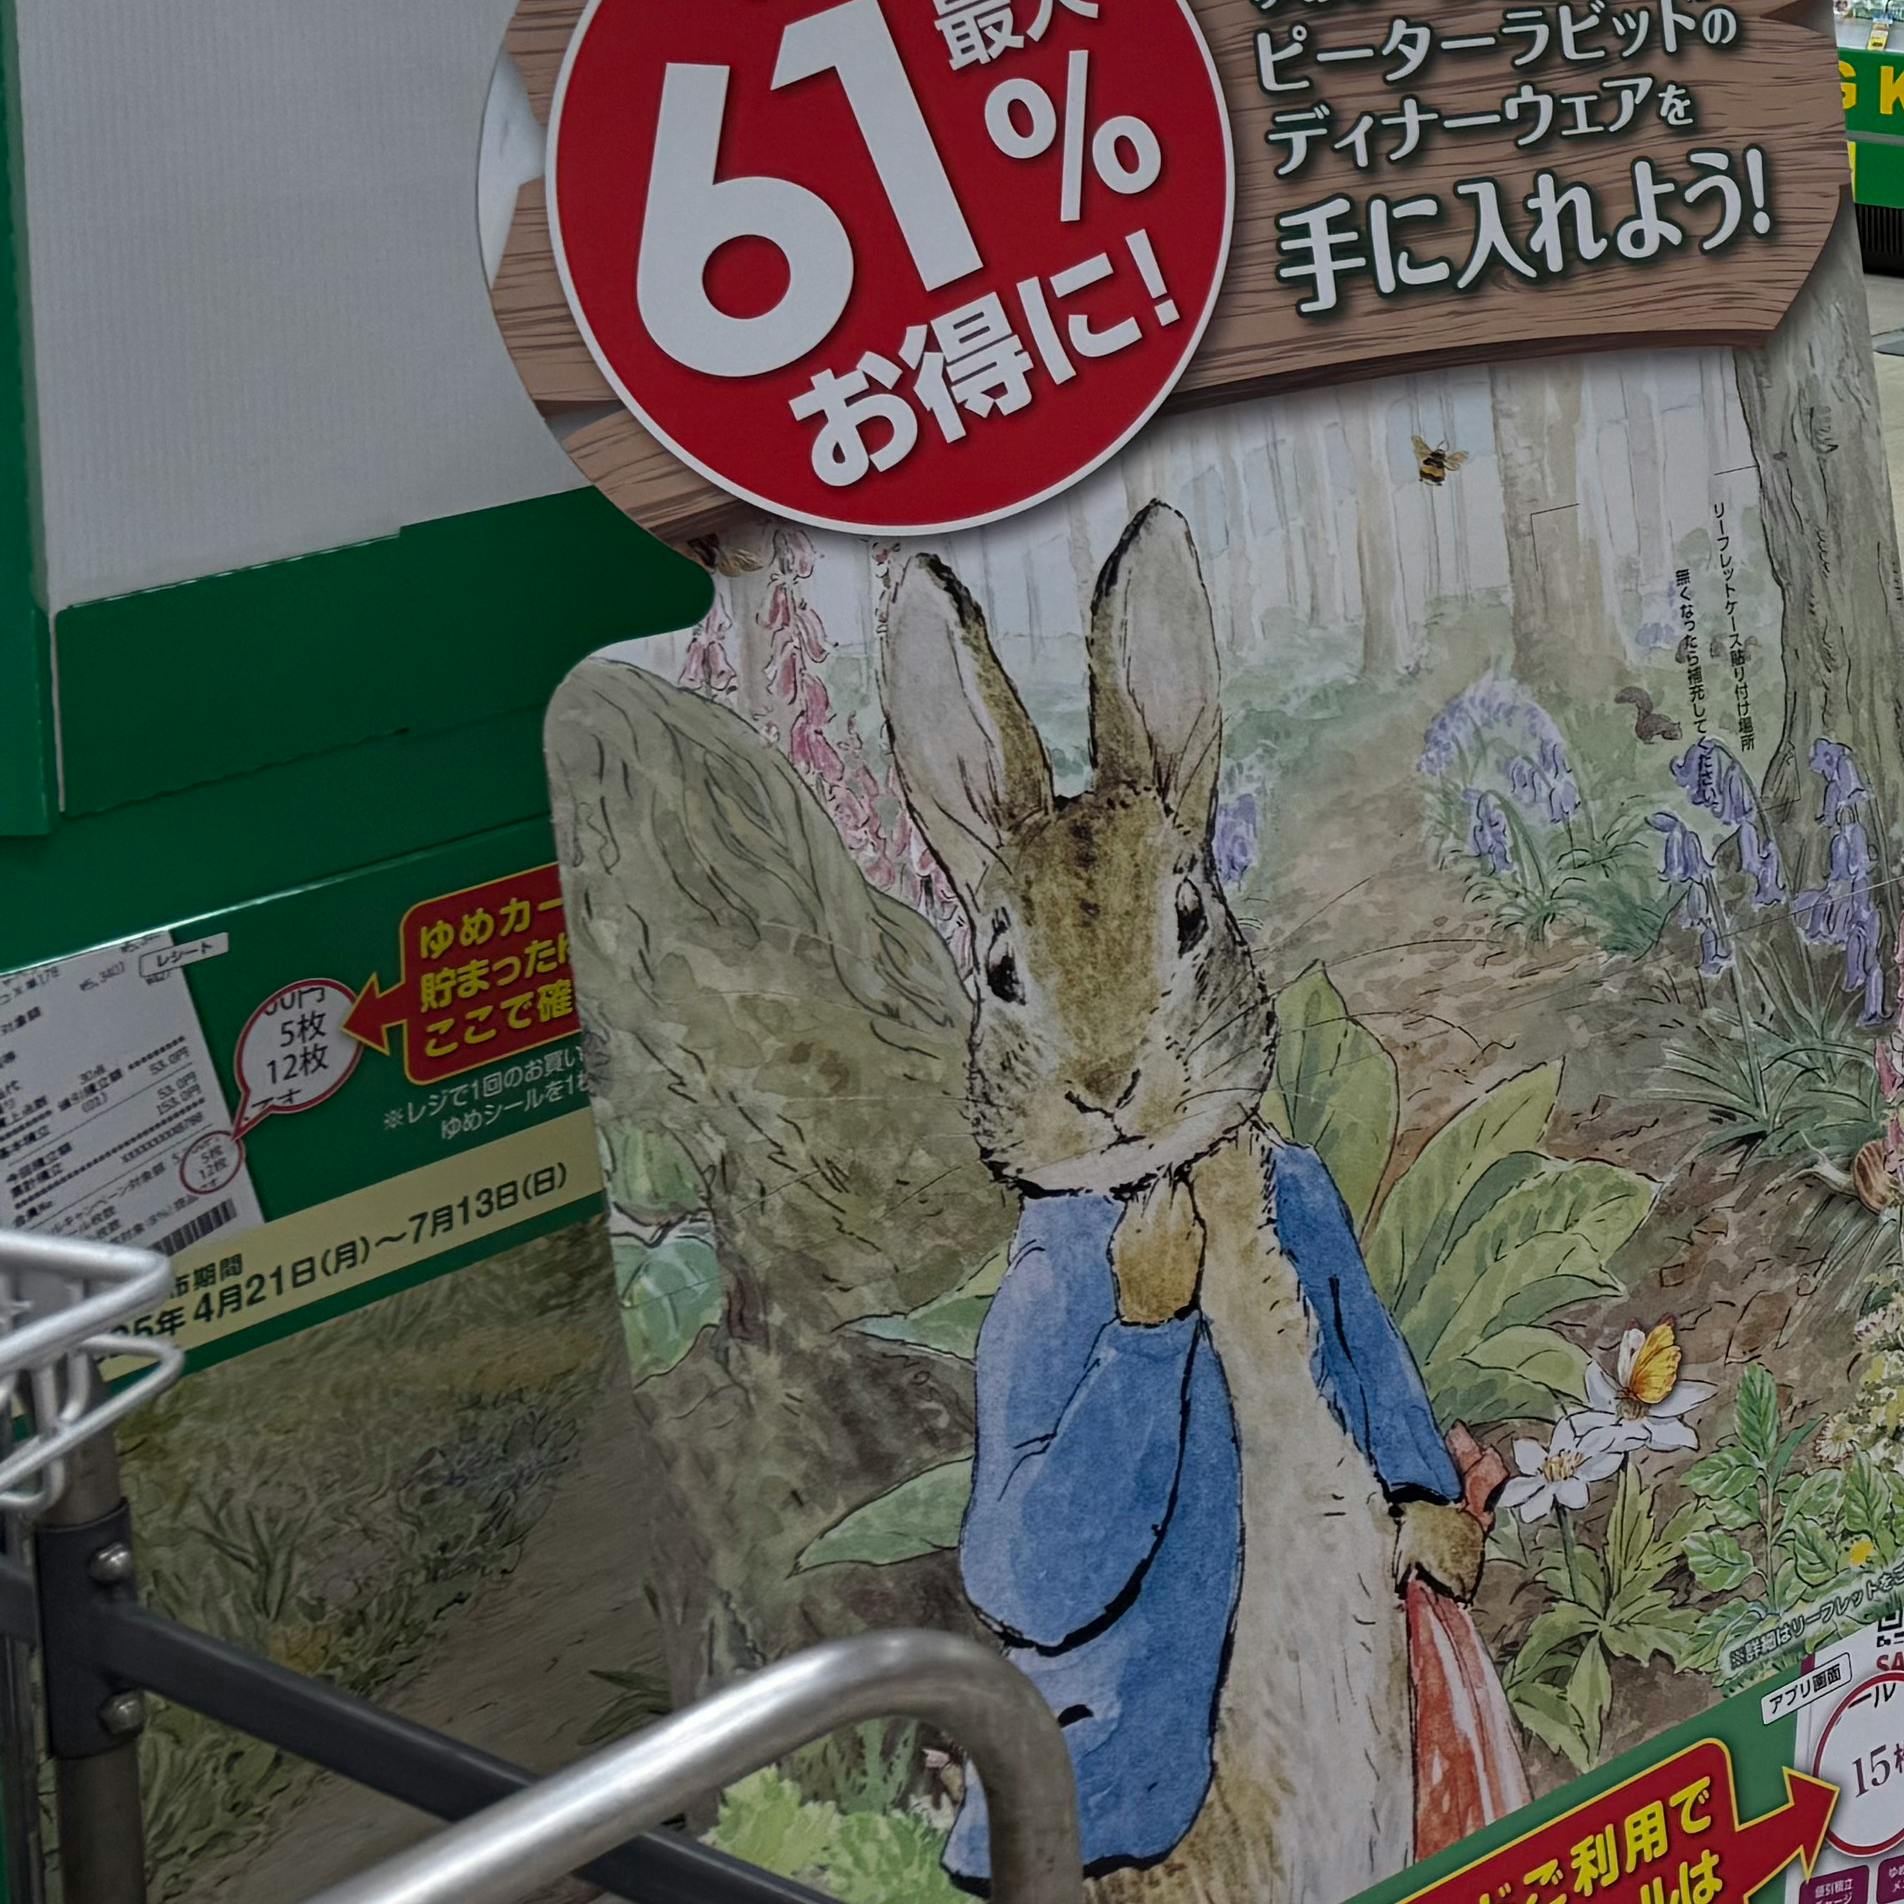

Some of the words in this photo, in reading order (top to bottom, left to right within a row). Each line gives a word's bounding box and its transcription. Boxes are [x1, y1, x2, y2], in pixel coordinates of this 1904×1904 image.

[1268, 76, 1695, 178] ディナーウェアを
[1277, 147, 1773, 316] 手に入れよう!
[788, 227, 1182, 489] お得に!
[155, 940, 214, 968] レシート
[278, 1009, 327, 1048] 5枚
[424, 978, 575, 1058] ここで確
[265, 1045, 329, 1086] 12枚
[1767, 1664, 1843, 1715] アプリ画面
